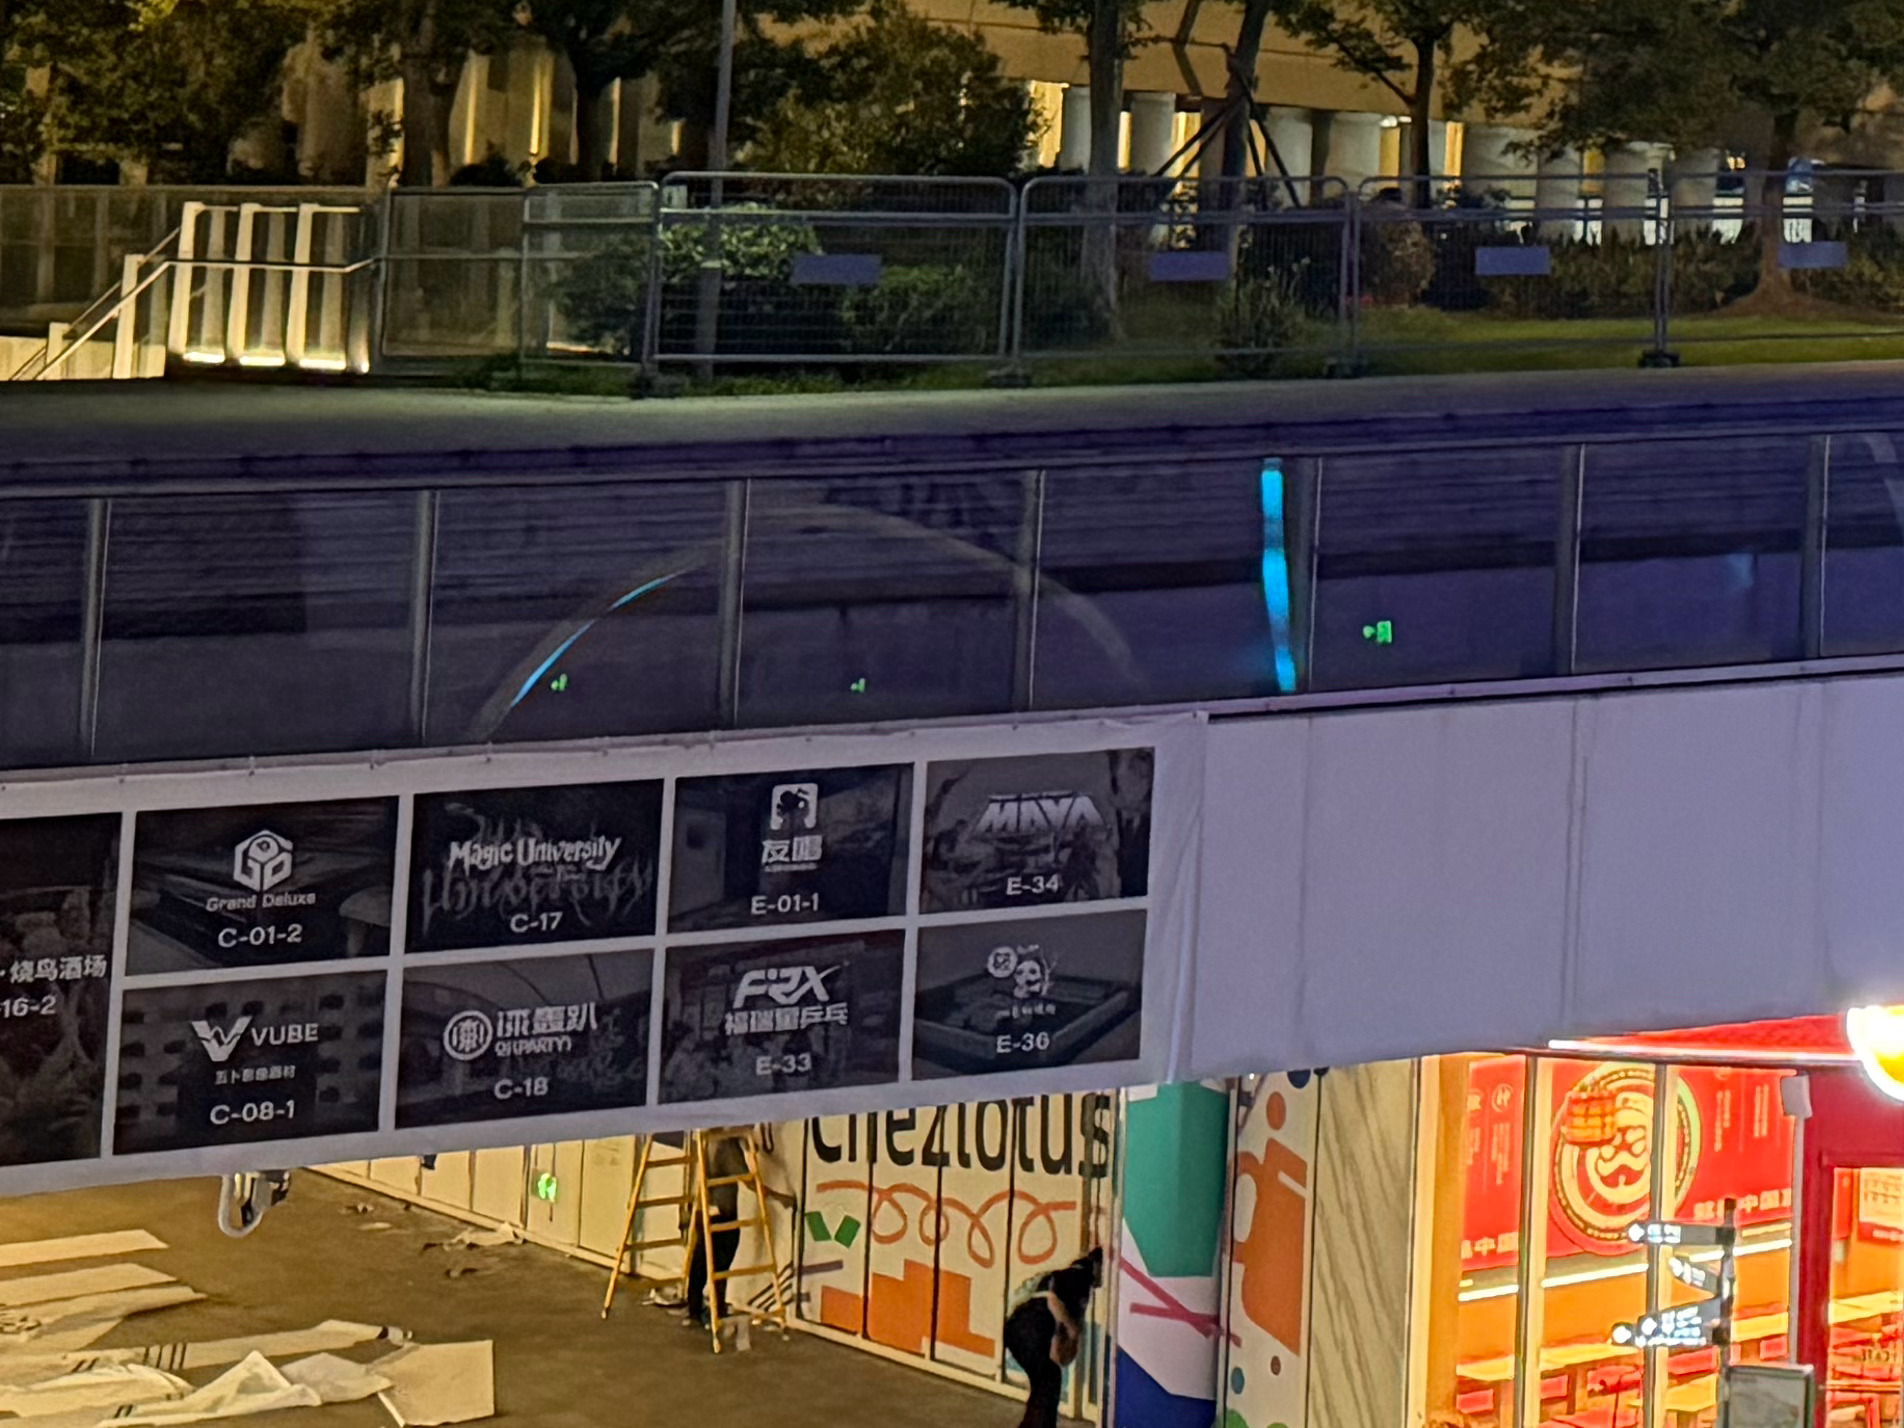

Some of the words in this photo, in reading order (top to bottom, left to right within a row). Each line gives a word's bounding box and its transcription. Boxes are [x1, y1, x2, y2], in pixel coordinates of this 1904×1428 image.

[449, 840, 514, 876] Magic
[516, 835, 622, 871] University
[1005, 875, 1060, 896] E-34
[205, 894, 257, 913] Grand
[262, 891, 317, 910] Deluxe
[751, 892, 820, 916] E-01-1
[509, 911, 564, 933] C-17
[217, 924, 303, 948] C-01-2
[250, 1021, 320, 1048] VUBE
[995, 1031, 1051, 1054] E-36
[754, 1051, 813, 1076] E-33
[493, 1076, 549, 1100] C-18
[209, 1099, 296, 1126] C-08-1
